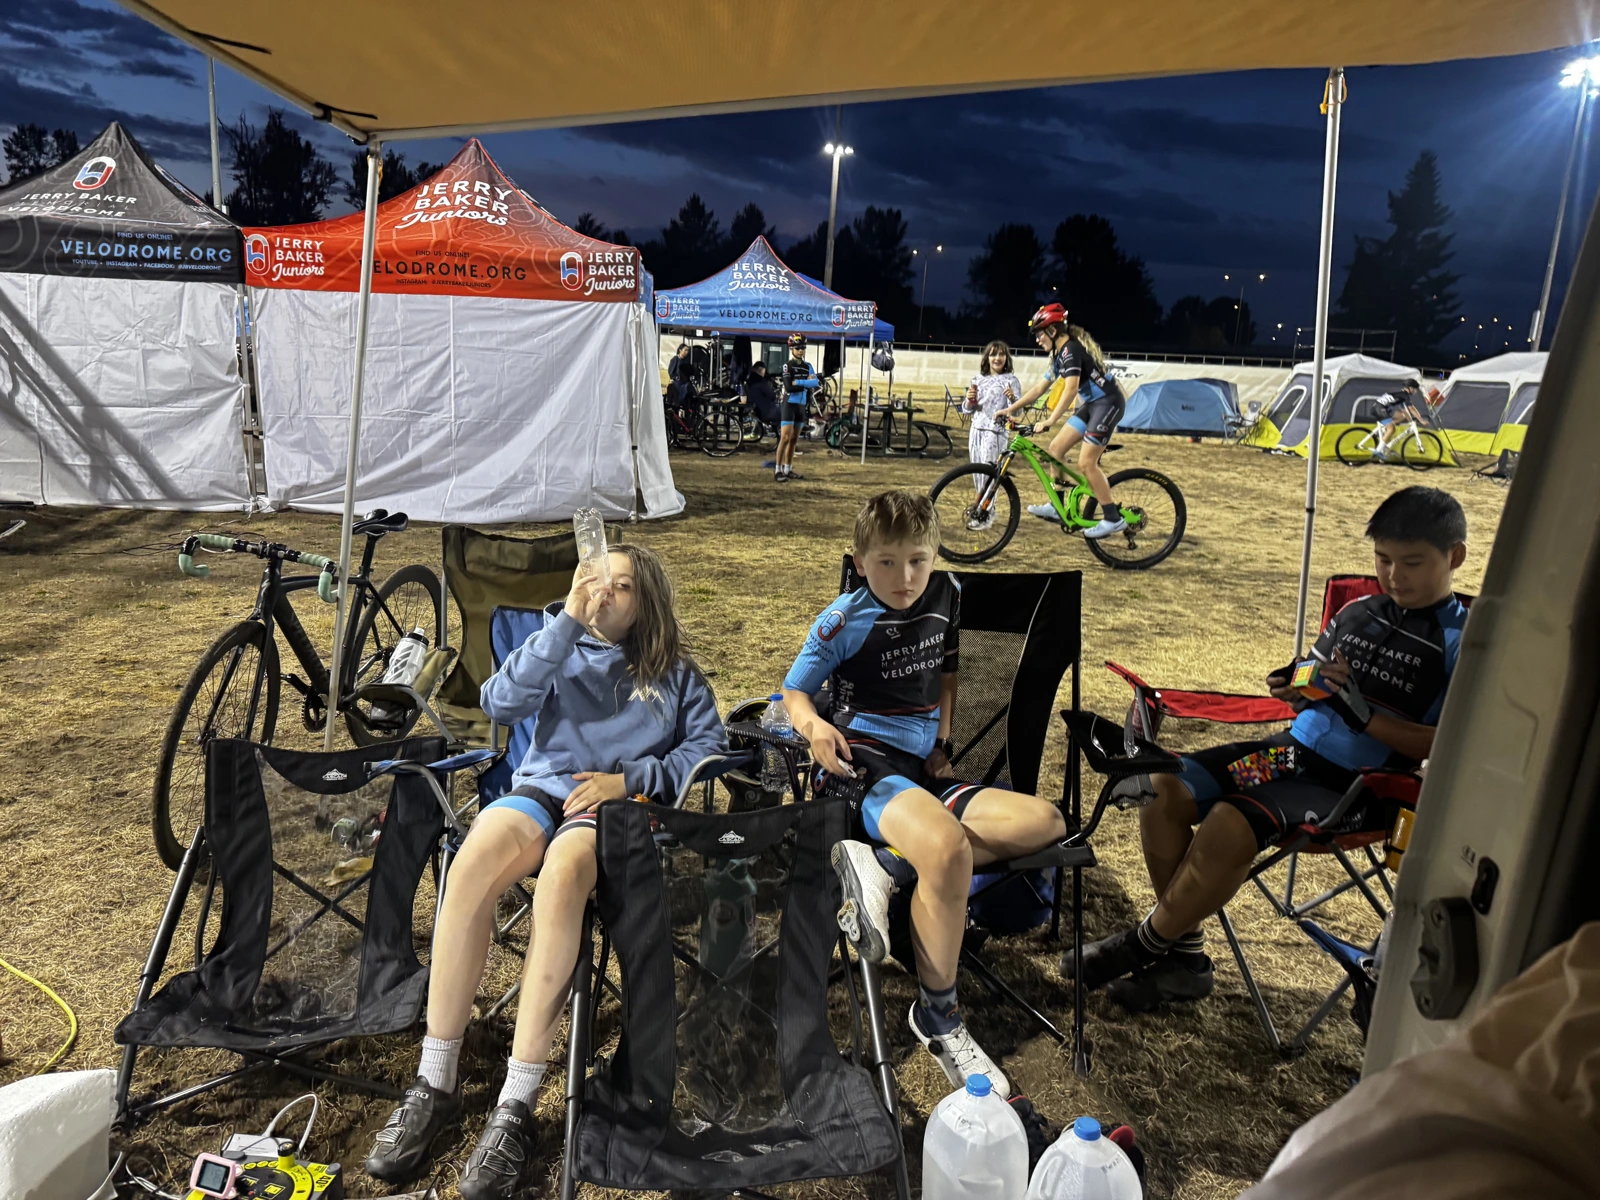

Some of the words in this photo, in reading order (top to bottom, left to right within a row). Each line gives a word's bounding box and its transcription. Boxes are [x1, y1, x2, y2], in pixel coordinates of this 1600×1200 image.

[416, 180, 513, 201] JERRY
[21, 192, 76, 201] JERRY
[79, 192, 138, 204] BAKER
[414, 193, 510, 216] BAKER
[7, 205, 127, 218] VELODROME
[394, 205, 509, 229] Juniors
[116, 231, 133, 239] FIND
[274, 236, 325, 251] JERRY
[60, 239, 233, 263] VELODROME.ORG
[275, 249, 325, 264] BAKER
[587, 252, 635, 264] JERRY
[271, 262, 326, 282] Juniors
[359, 259, 528, 282] ELODROME.ORG
[588, 264, 636, 277] BAKER
[732, 262, 789, 276] JERRY
[733, 271, 790, 285] BAKER
[583, 276, 636, 297] Juniors
[727, 280, 791, 292] Juniors
[672, 297, 701, 305] JERRY
[673, 304, 701, 312] BAKER
[718, 309, 814, 323] VELODROME.ORG
[847, 305, 875, 313] JERRY
[847, 312, 875, 320] BAKER
[843, 317, 875, 330] Juniors
[881, 644, 917, 662] JERRY
[919, 632, 945, 650] BAKER
[1341, 633, 1378, 652] JERRY
[1378, 645, 1423, 667] BAKER
[881, 655, 945, 680] VELODROM
